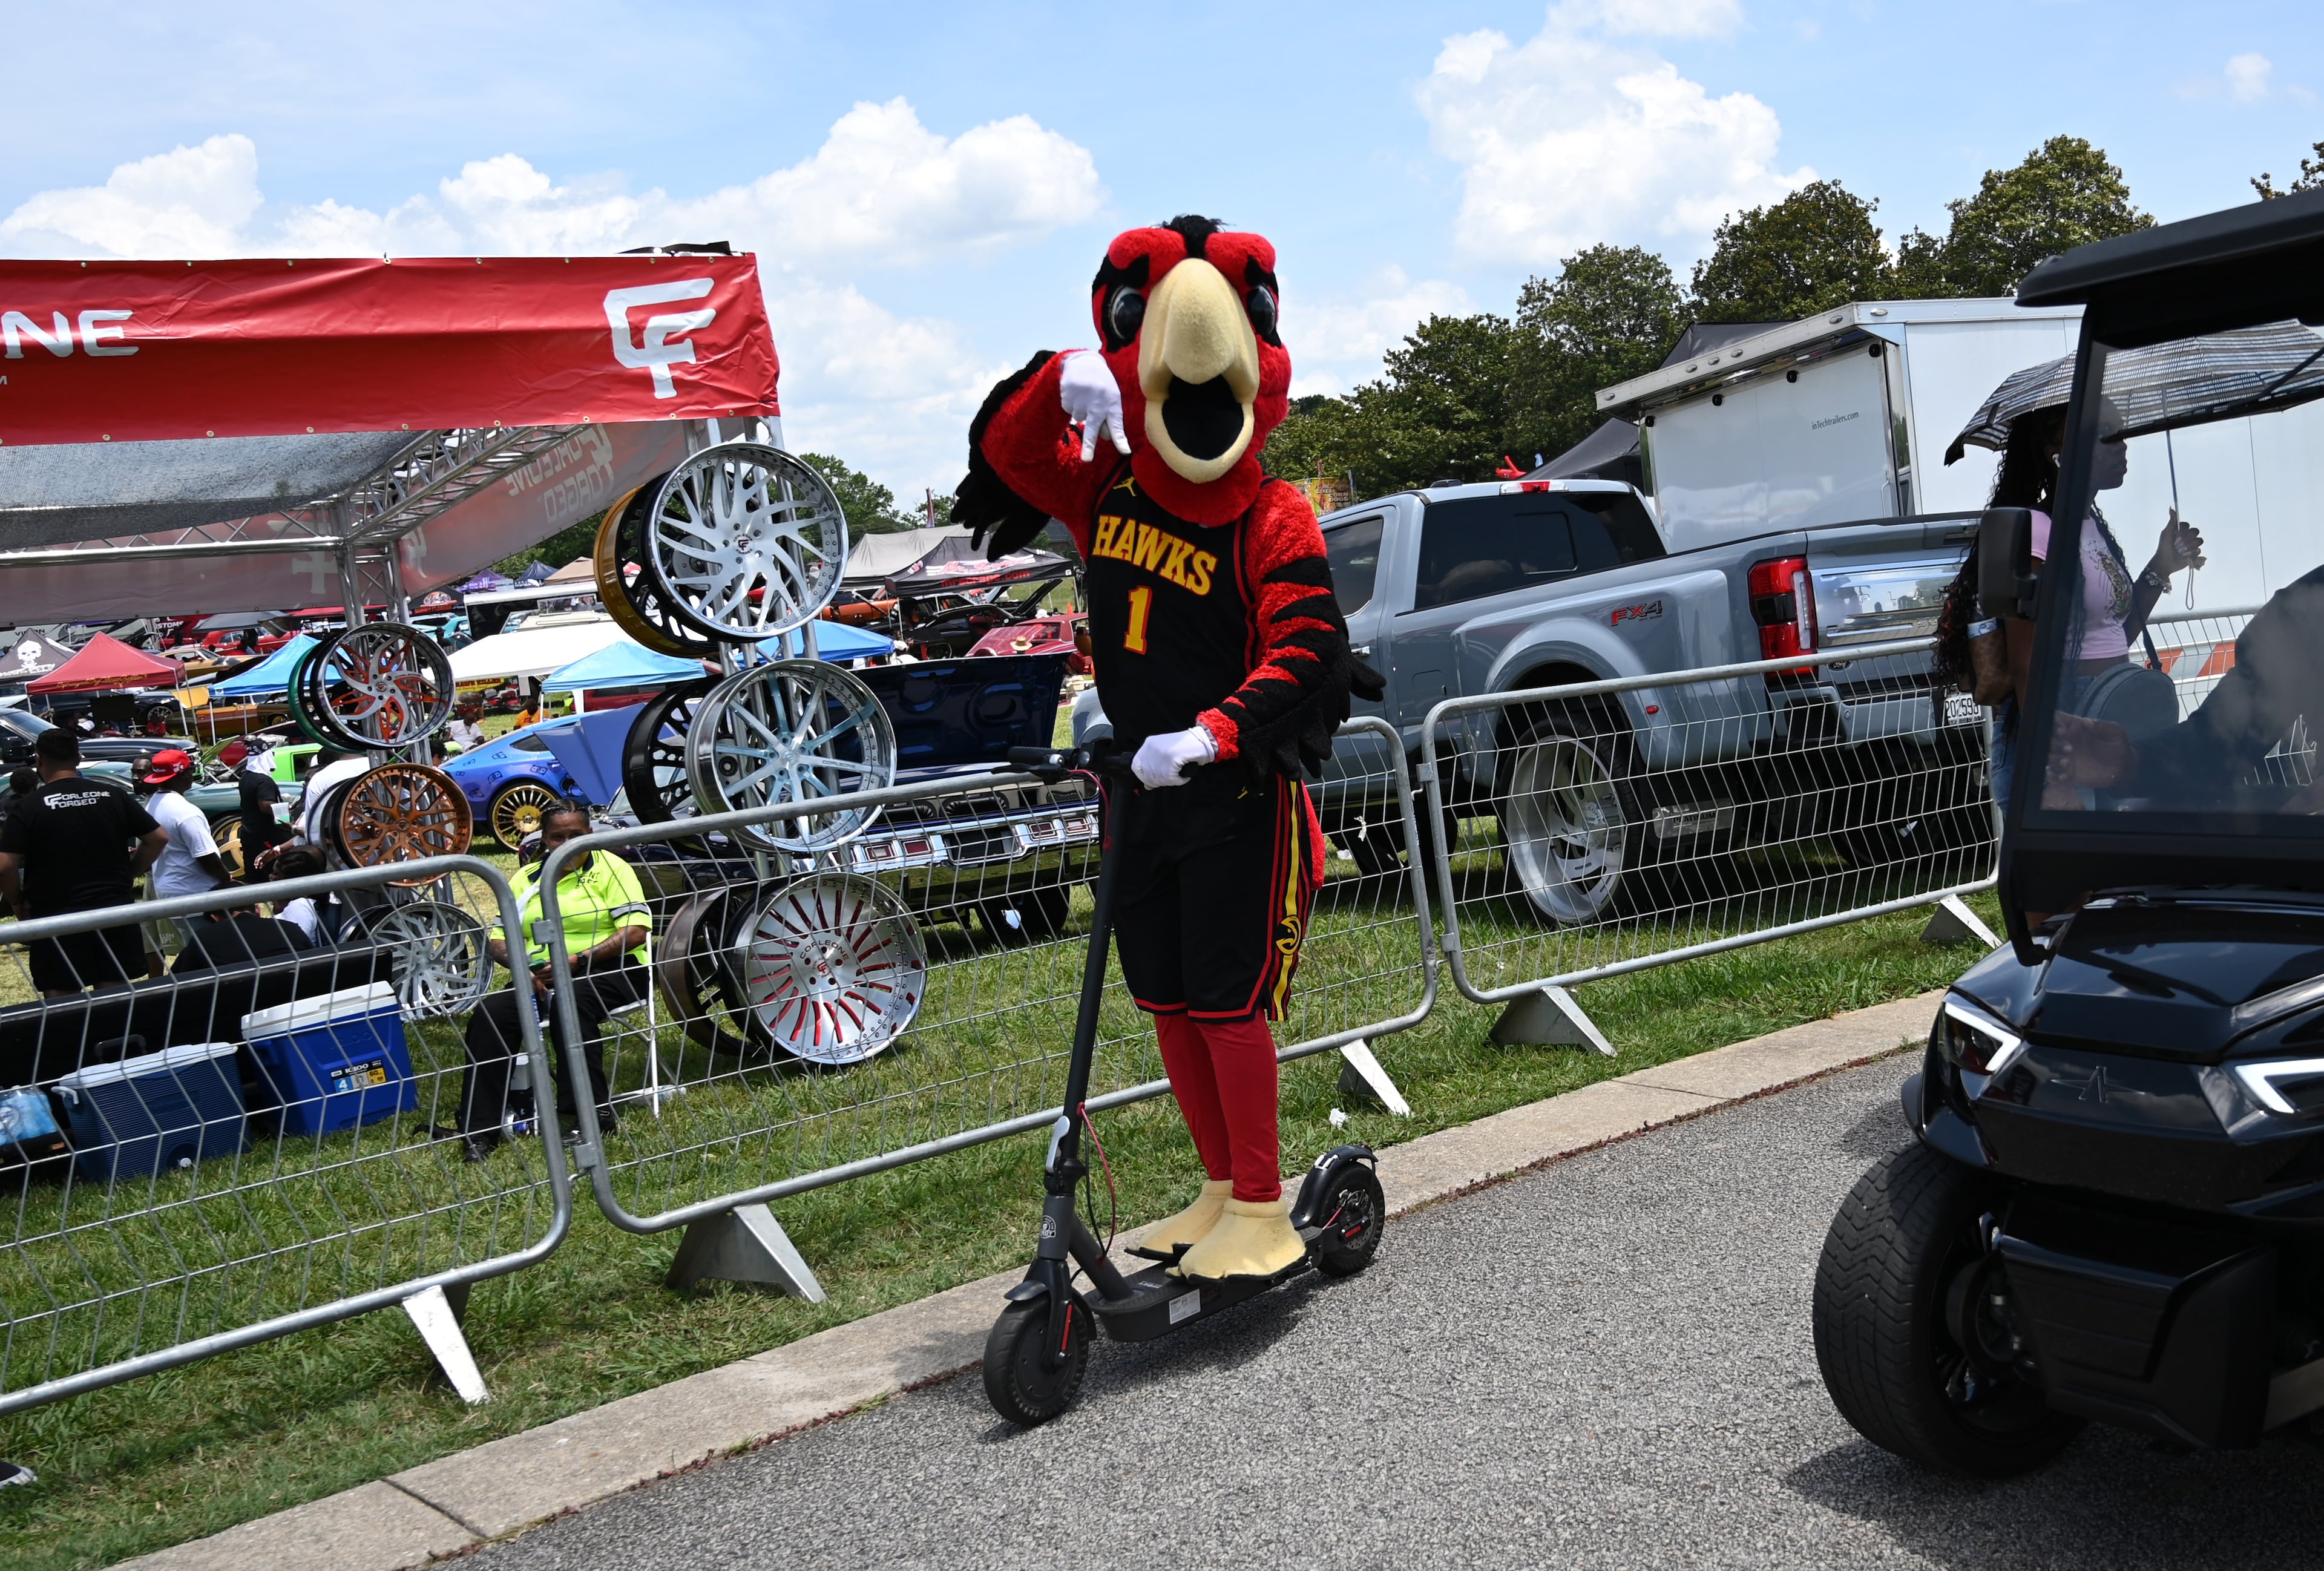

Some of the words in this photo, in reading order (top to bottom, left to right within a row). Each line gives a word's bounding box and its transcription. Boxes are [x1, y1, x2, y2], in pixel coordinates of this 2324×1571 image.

[1811, 412, 1859, 430] inTechtrailers.com
[1092, 514, 1217, 596] HAWKS
[1124, 585, 1152, 655] 1
[1611, 600, 1663, 626] FX4
[822, 759, 856, 769] CORLEONE
[800, 940, 849, 961] CORLEONE
[345, 1063, 369, 1074] IGLOO
[339, 1079, 348, 1089] 4
